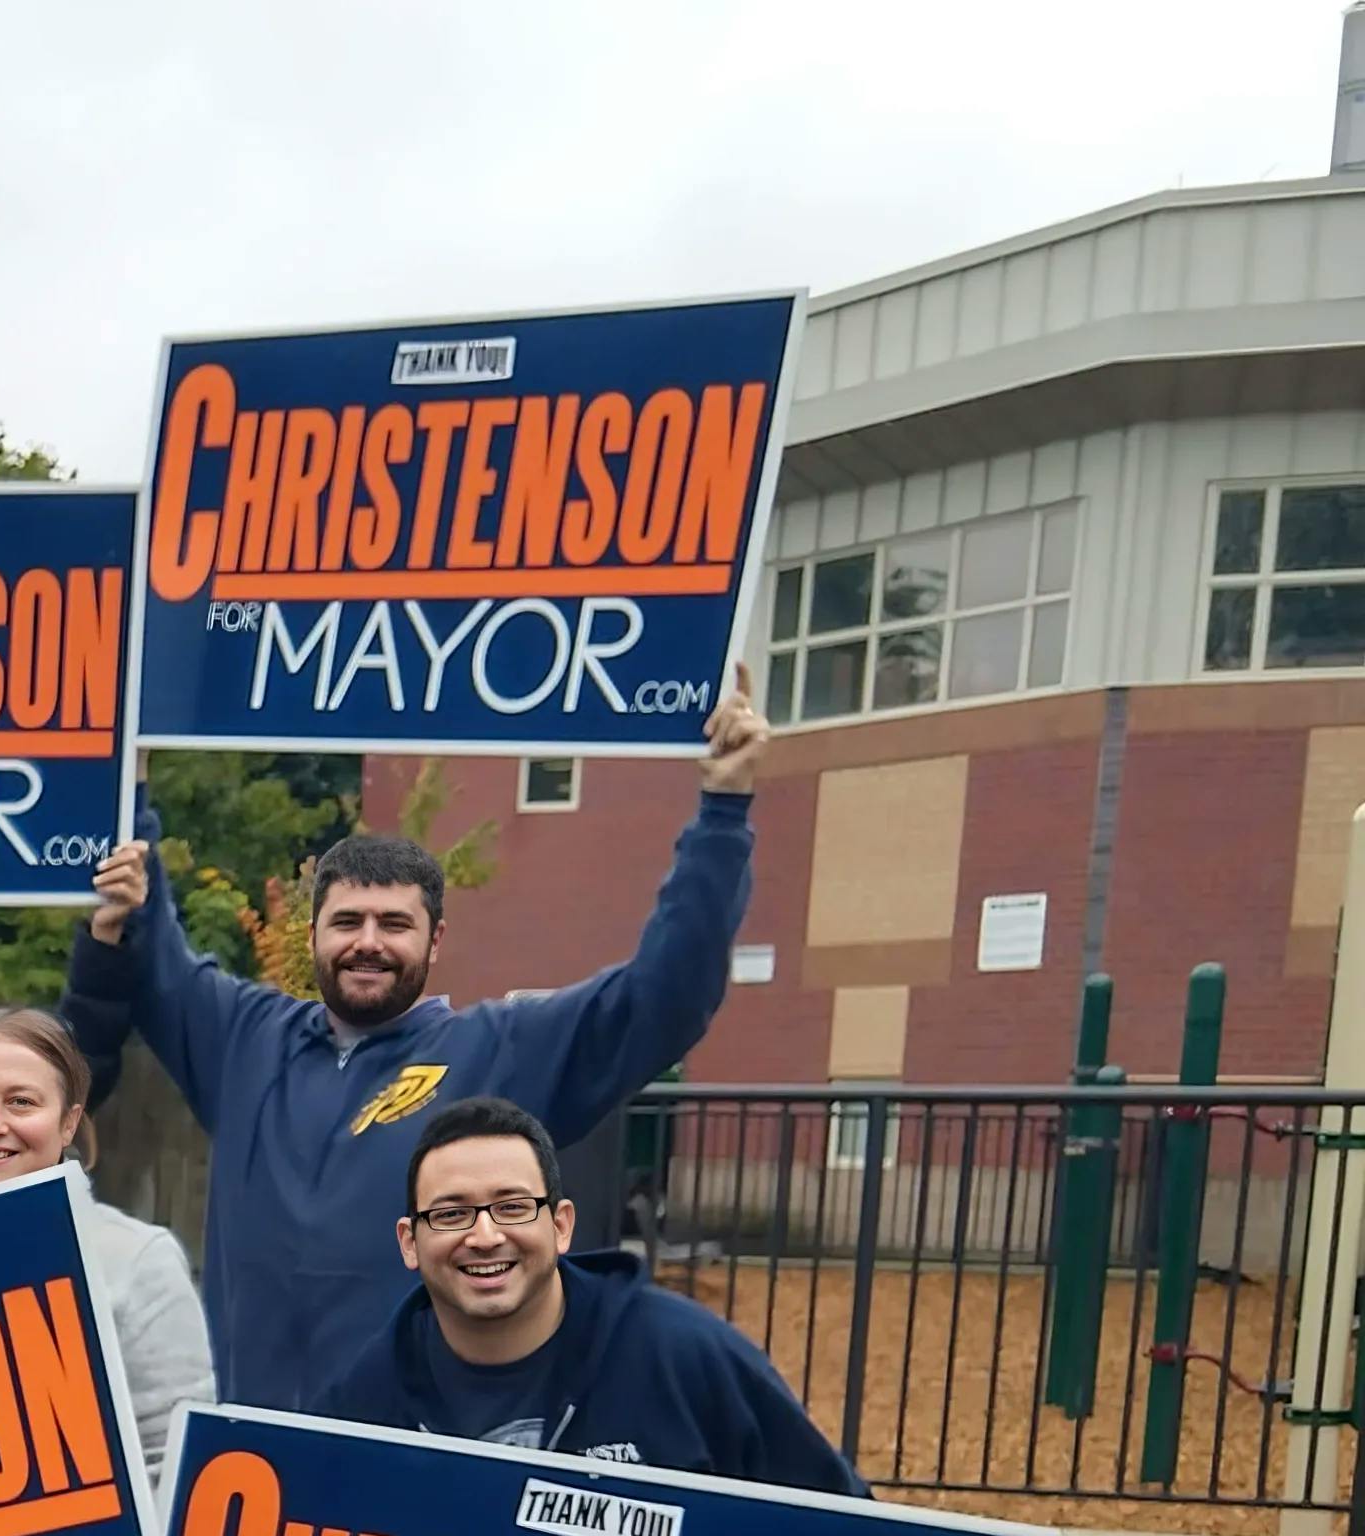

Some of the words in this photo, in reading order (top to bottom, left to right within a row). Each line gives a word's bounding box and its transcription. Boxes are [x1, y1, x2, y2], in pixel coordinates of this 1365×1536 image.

[397, 346, 459, 379] THANK
[150, 364, 766, 601] CHRISTENSON
[207, 600, 261, 631] FOR
[524, 1489, 611, 1536] THANK
